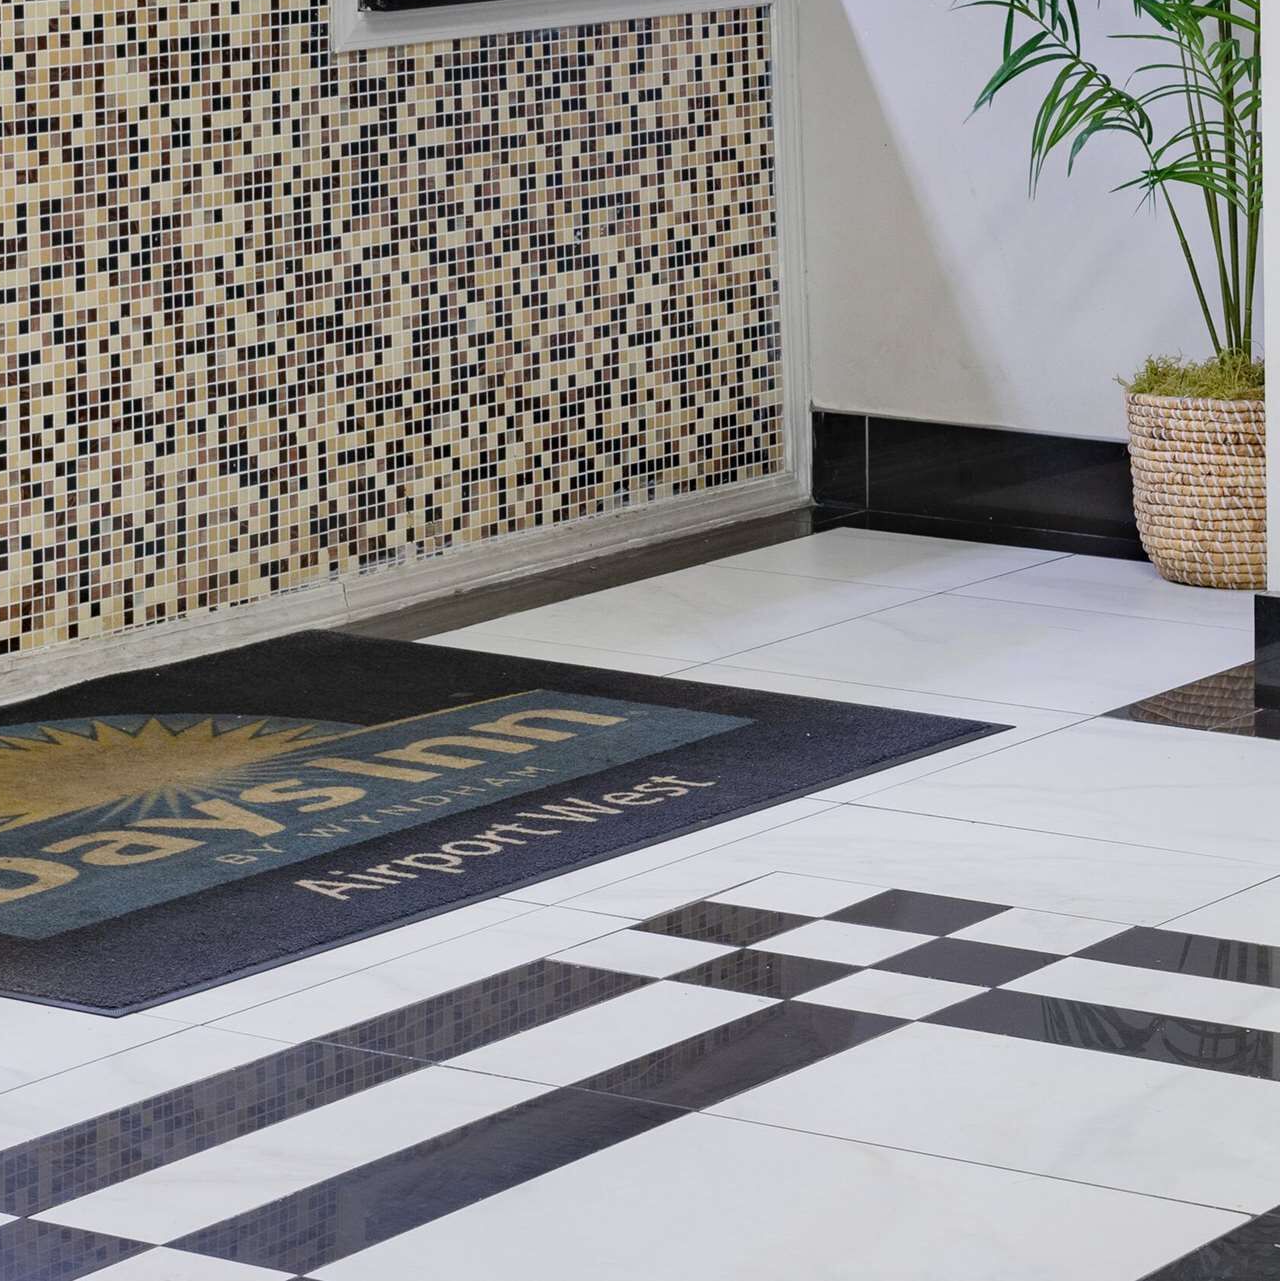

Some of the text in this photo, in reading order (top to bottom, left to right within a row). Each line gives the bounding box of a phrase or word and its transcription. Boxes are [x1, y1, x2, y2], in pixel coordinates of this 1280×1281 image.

[304, 708, 629, 783] Inn
[214, 765, 556, 866] BY WYNDHAM
[295, 774, 717, 902] Airport West
